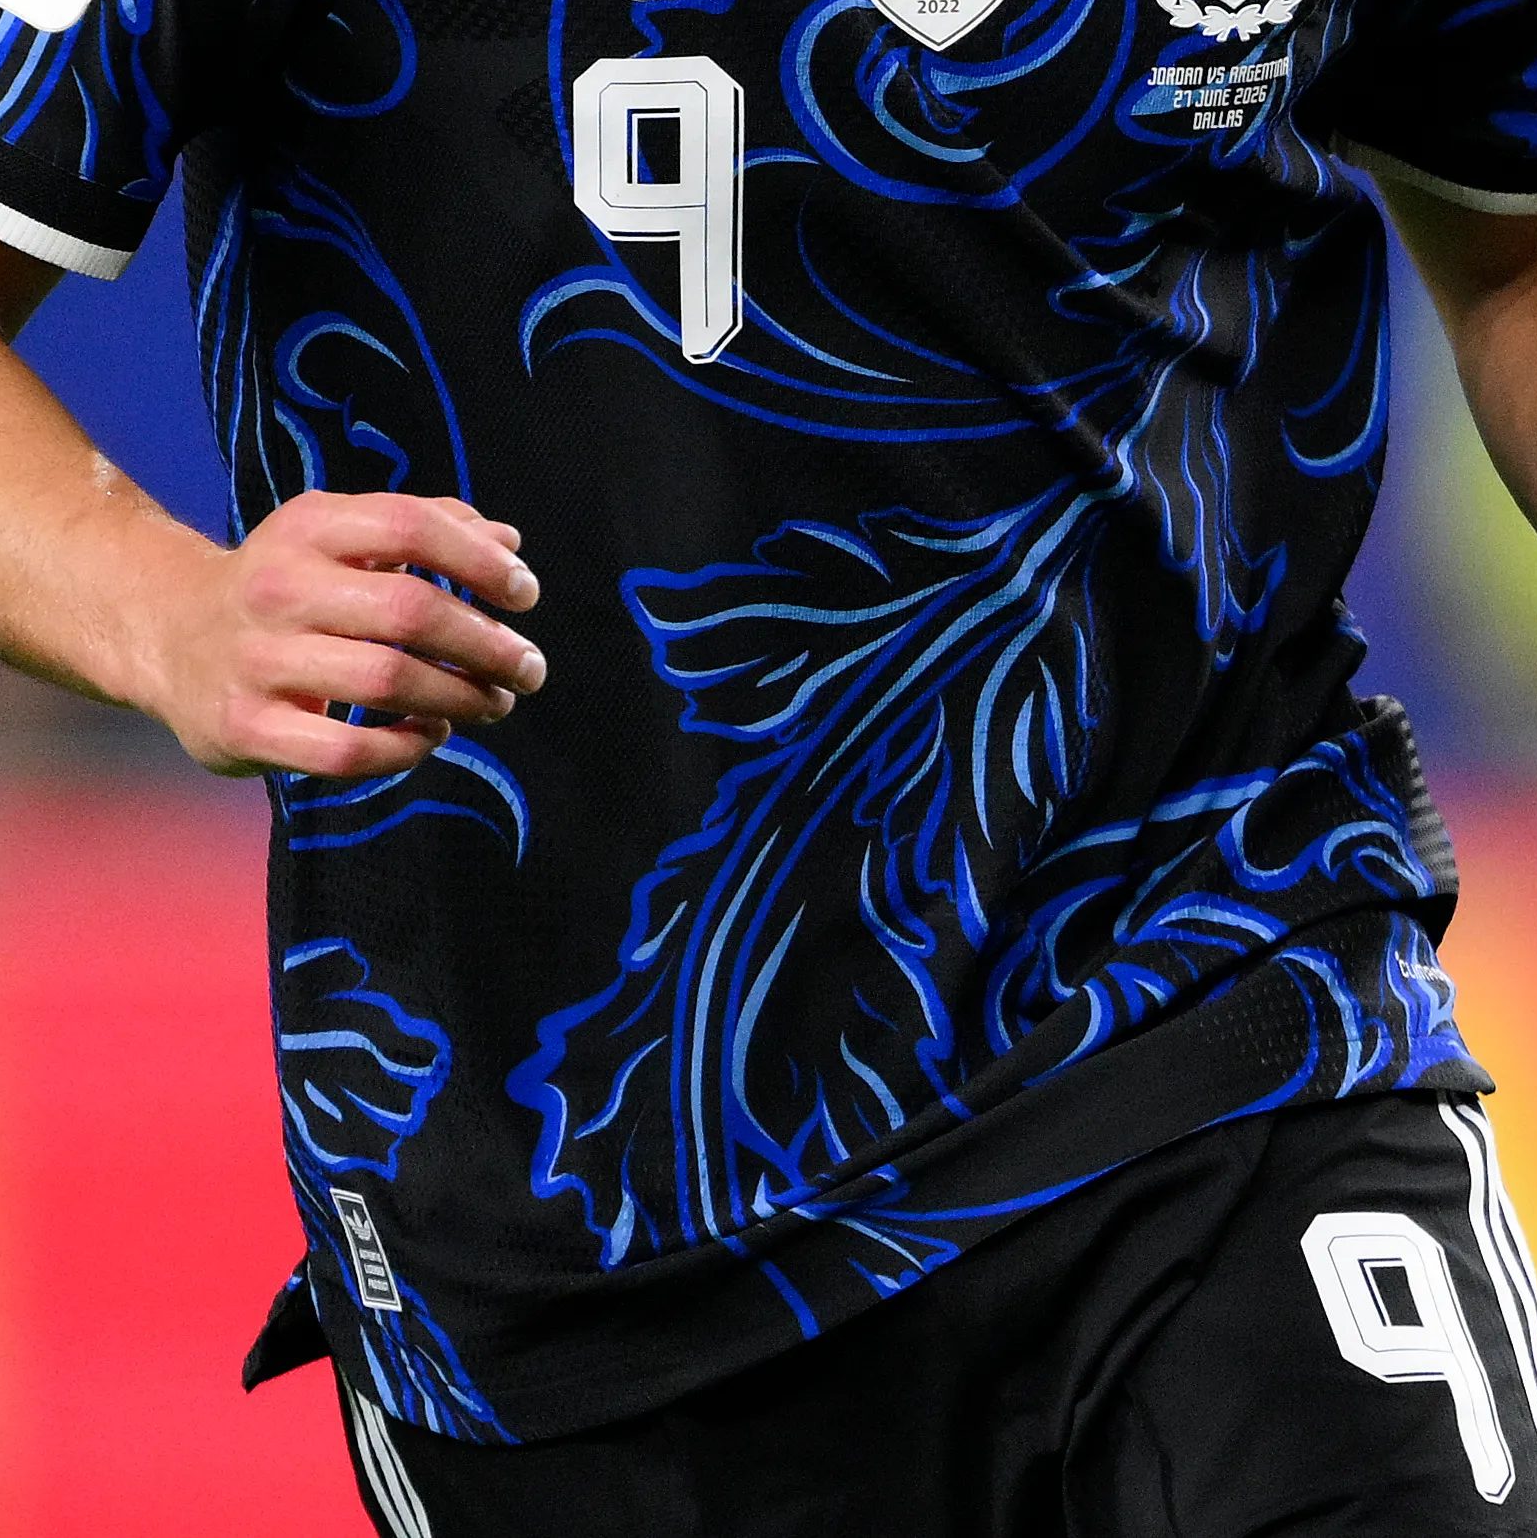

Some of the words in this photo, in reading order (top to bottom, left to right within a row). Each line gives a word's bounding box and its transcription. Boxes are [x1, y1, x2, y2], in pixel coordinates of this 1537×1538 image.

[917, 0, 960, 14] 2022
[1147, 67, 1203, 86] JORDAN
[1207, 66, 1226, 84] VS
[1228, 56, 1290, 84] ARGENTINA
[1173, 90, 1192, 108] 27
[1195, 89, 1232, 108] JUNE
[1234, 85, 1268, 105] 2026
[1193, 109, 1244, 130] DALLAS
[573, 56, 744, 364] 9
[1300, 1212, 1516, 1504] 9
